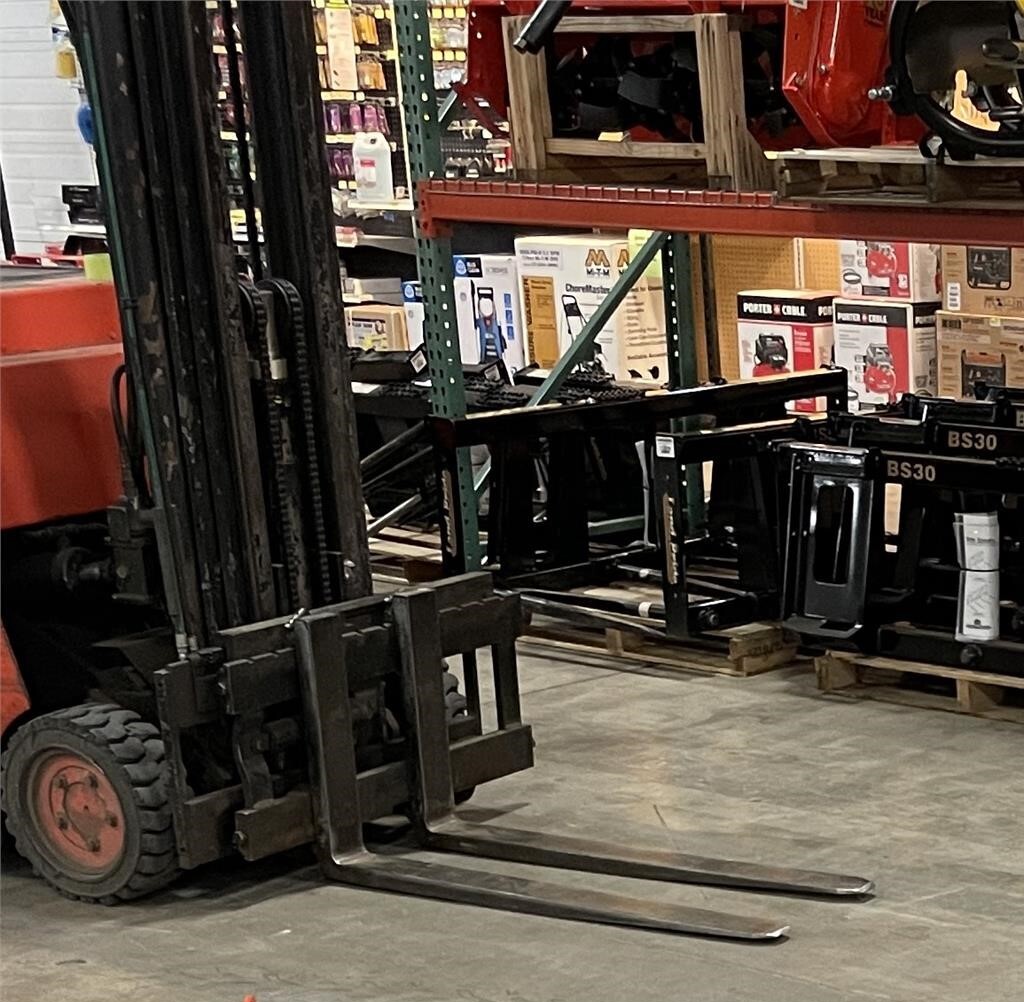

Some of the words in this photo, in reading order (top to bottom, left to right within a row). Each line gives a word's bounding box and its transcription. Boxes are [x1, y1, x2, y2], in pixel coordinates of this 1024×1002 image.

[743, 302, 773, 314] PORTER
[782, 304, 807, 317] CABLE
[947, 431, 998, 451] BS30
[887, 460, 937, 482] BS30
